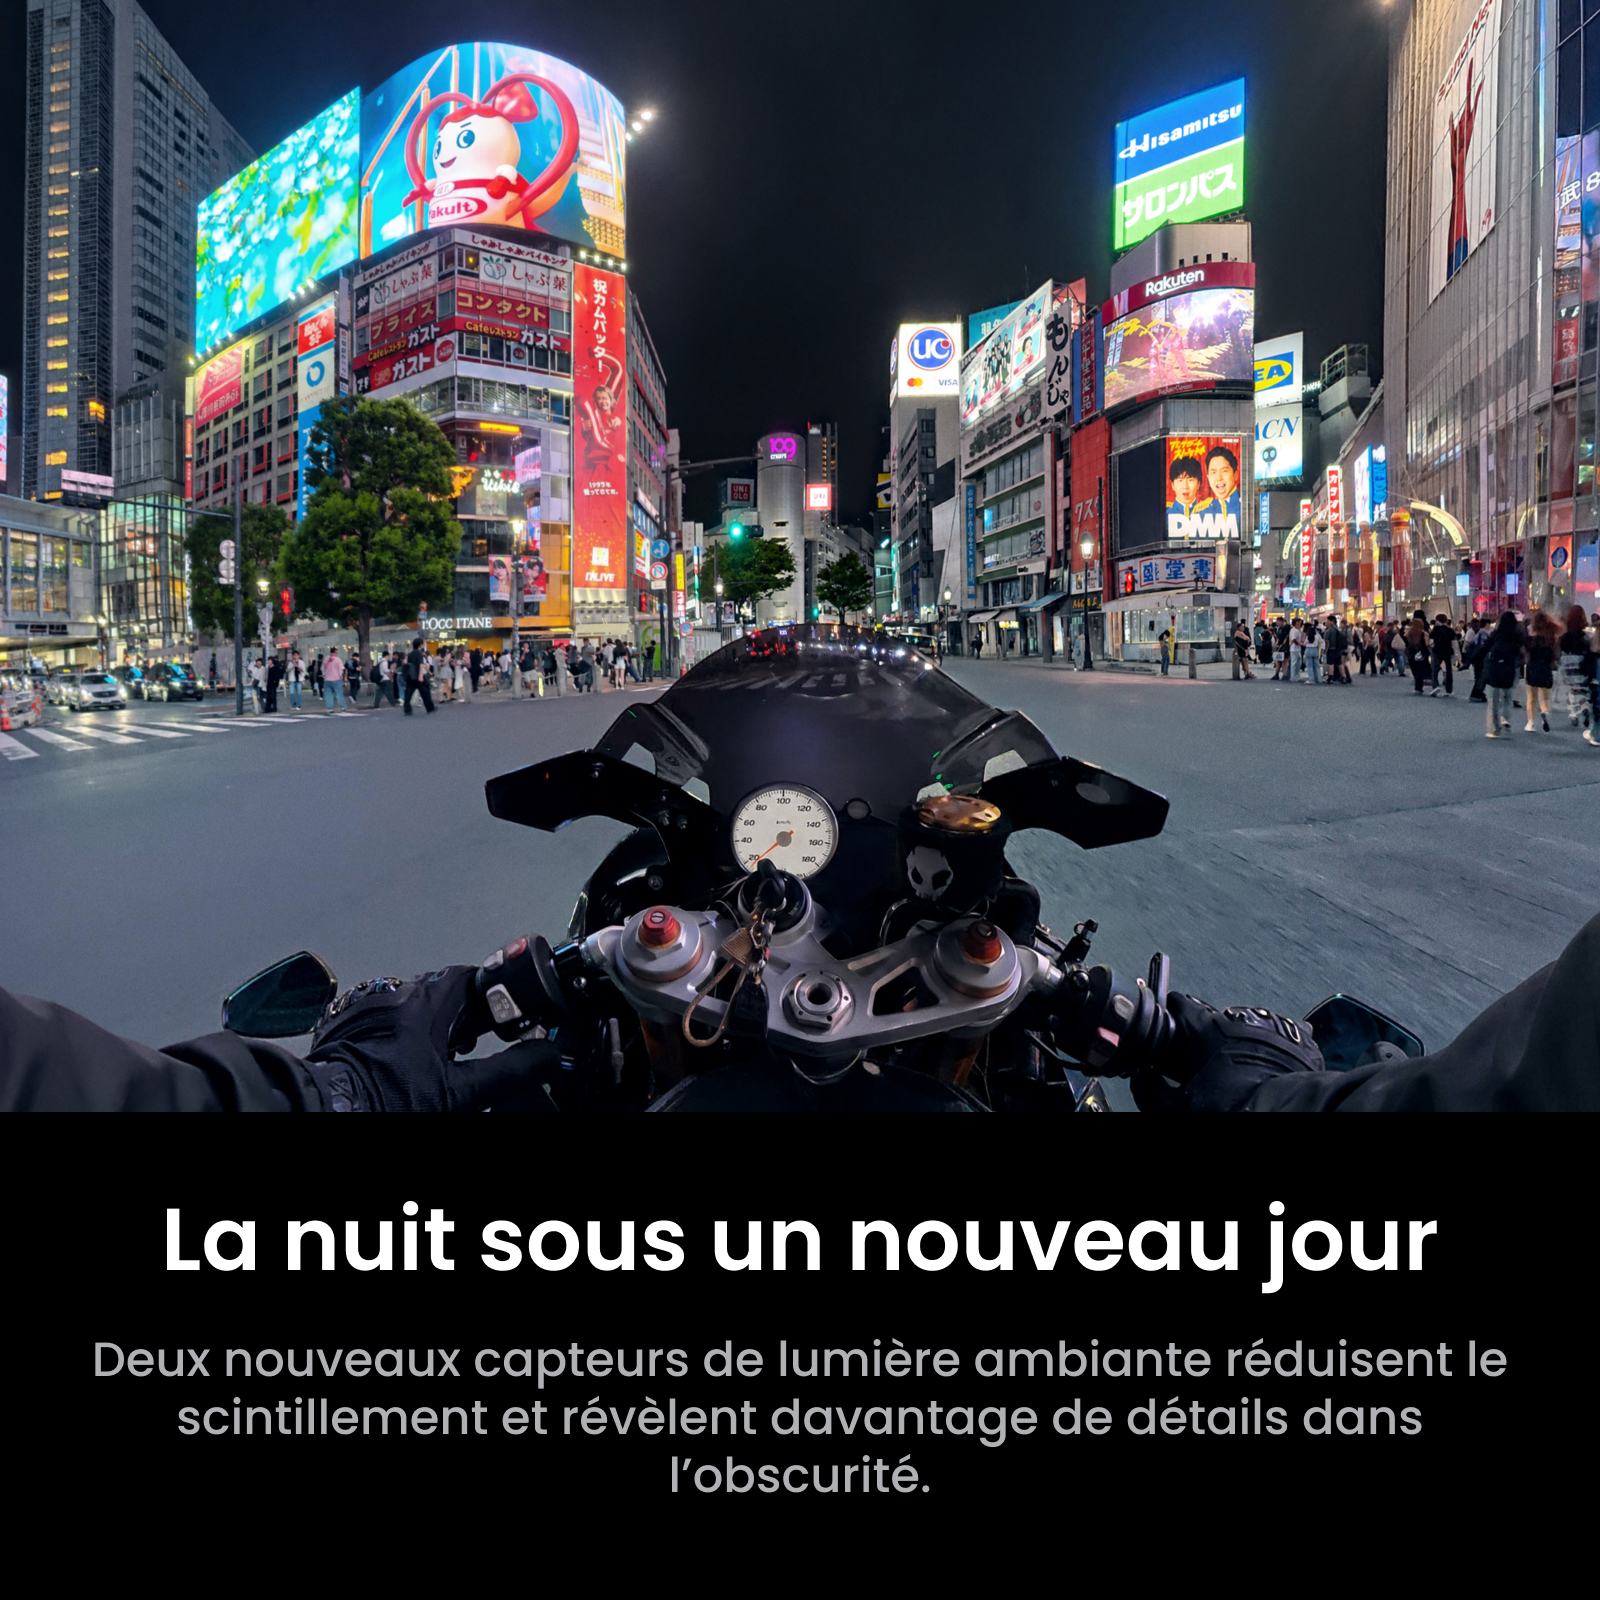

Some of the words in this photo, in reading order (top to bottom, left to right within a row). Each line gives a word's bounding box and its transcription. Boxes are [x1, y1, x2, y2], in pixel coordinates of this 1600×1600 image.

[1118, 103, 1242, 159] Hisamitsu
[1122, 162, 1237, 229] サロンパス
[1145, 269, 1205, 297] Rakuten
[457, 291, 547, 323] コンタクト
[408, 323, 441, 348] ガスト
[520, 329, 562, 350] ガスト
[392, 352, 432, 382] ガスト
[1046, 312, 1070, 406] もんじゃ
[938, 379, 959, 387] VISA
[1254, 363, 1286, 382] EA
[769, 437, 797, 459] 109
[733, 485, 748, 493] UNI
[733, 492, 748, 500] QLO
[1168, 513, 1239, 538] DMM
